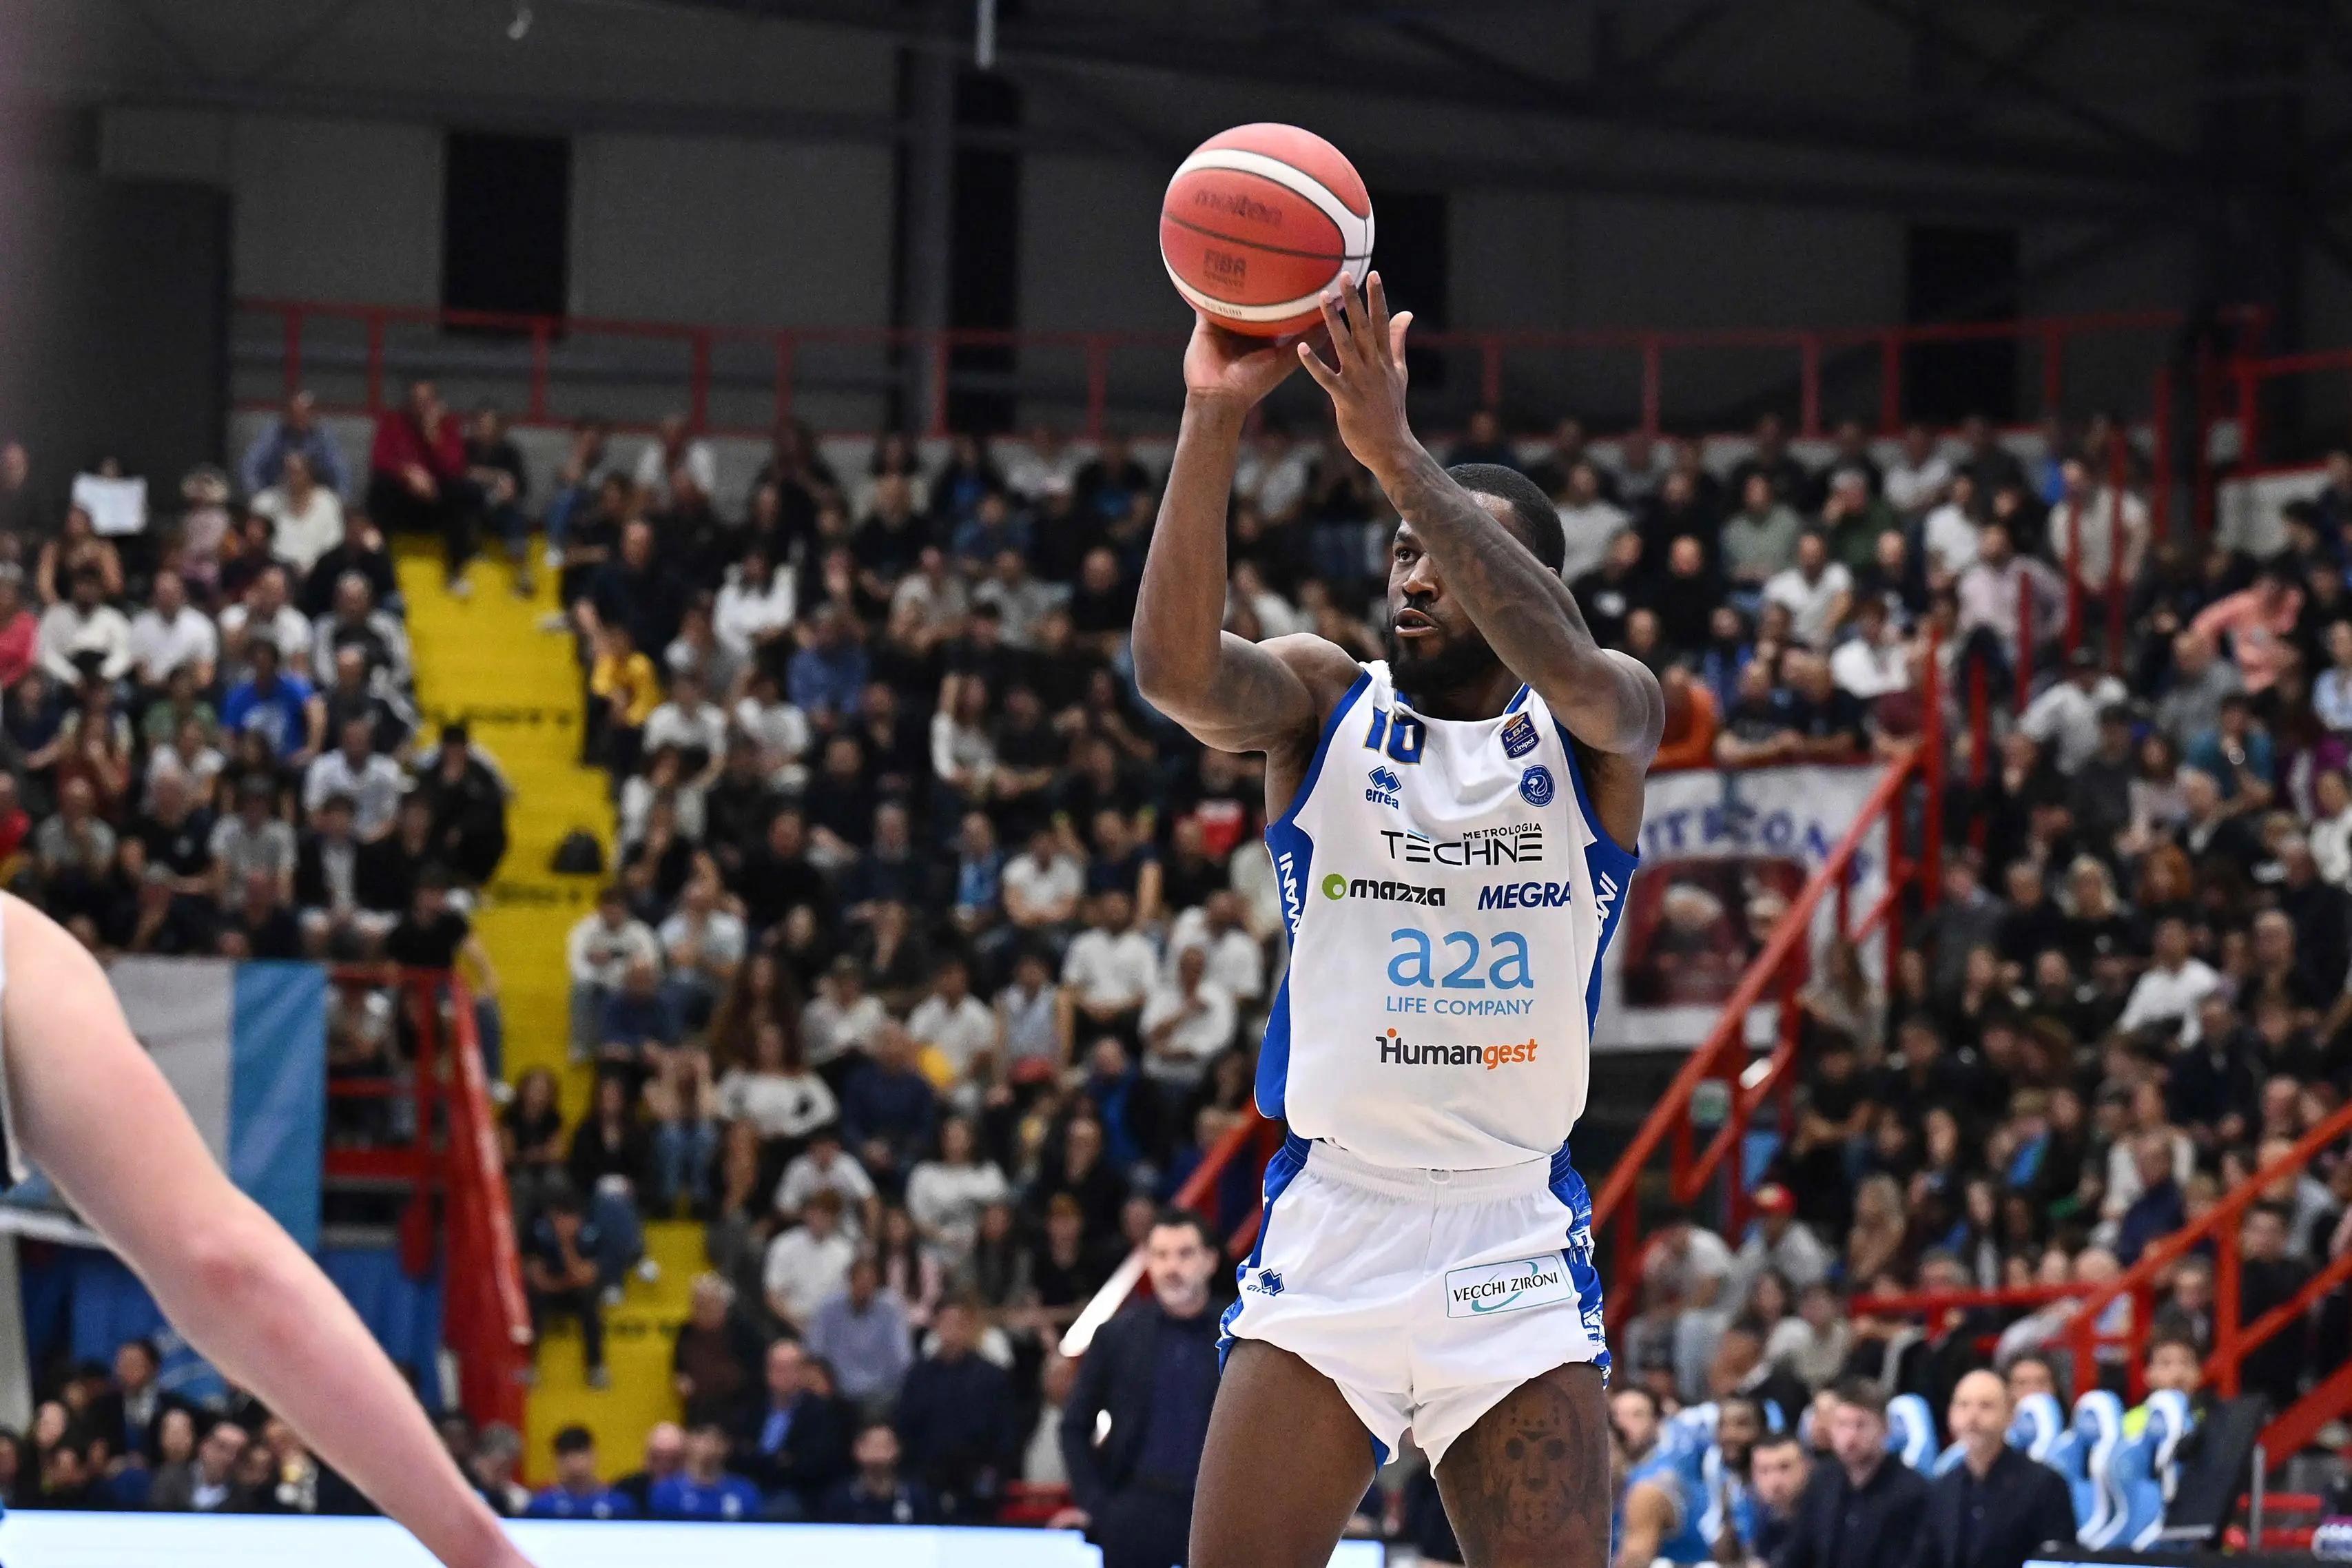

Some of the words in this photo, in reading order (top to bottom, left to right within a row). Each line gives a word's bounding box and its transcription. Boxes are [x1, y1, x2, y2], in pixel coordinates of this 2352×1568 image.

[1204, 249, 1246, 276] FIBA
[1362, 707, 1427, 765] 10
[1505, 723, 1529, 742] LBA
[1513, 736, 1535, 752] Unipol
[1525, 792, 1551, 803] BRESCIA
[1463, 823, 1543, 839] METROLOGIA
[1350, 878, 1445, 907] mazza
[1387, 928, 1534, 990] a2a
[1386, 996, 1427, 1013] LIFE
[1434, 999, 1534, 1015] COMPANY
[1375, 1028, 1538, 1070] Humangest
[1453, 1281, 1506, 1302] VECCHI
[1511, 1272, 1558, 1292] ZIRONI
